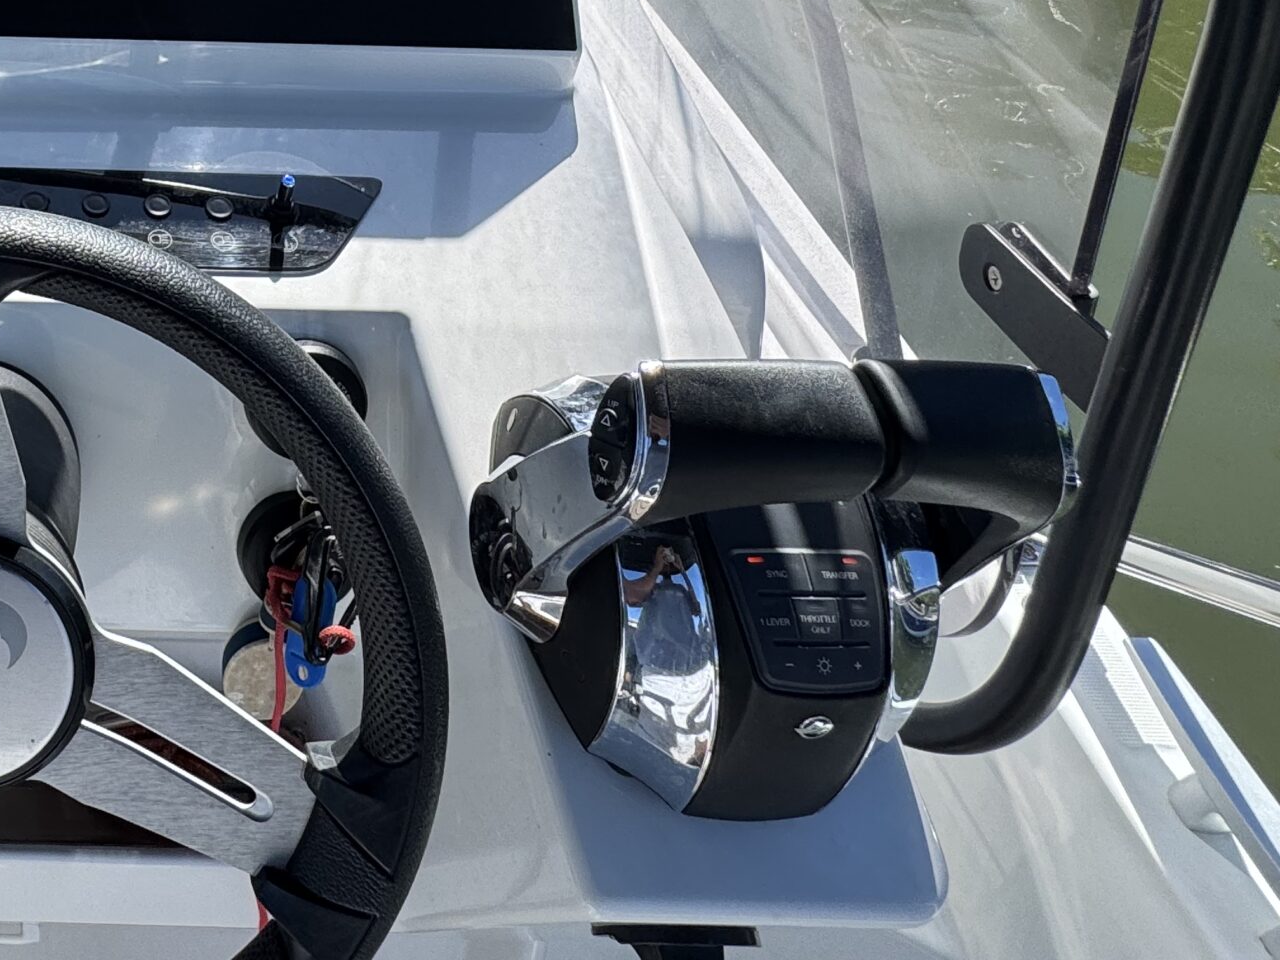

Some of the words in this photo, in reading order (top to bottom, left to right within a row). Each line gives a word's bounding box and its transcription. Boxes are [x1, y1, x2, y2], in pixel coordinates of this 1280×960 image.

[766, 569, 788, 579] SYNC
[821, 570, 860, 580] TRANSFER
[766, 617, 791, 627] LEVER
[800, 614, 838, 624] THROTTLE
[811, 625, 831, 634] ONLY
